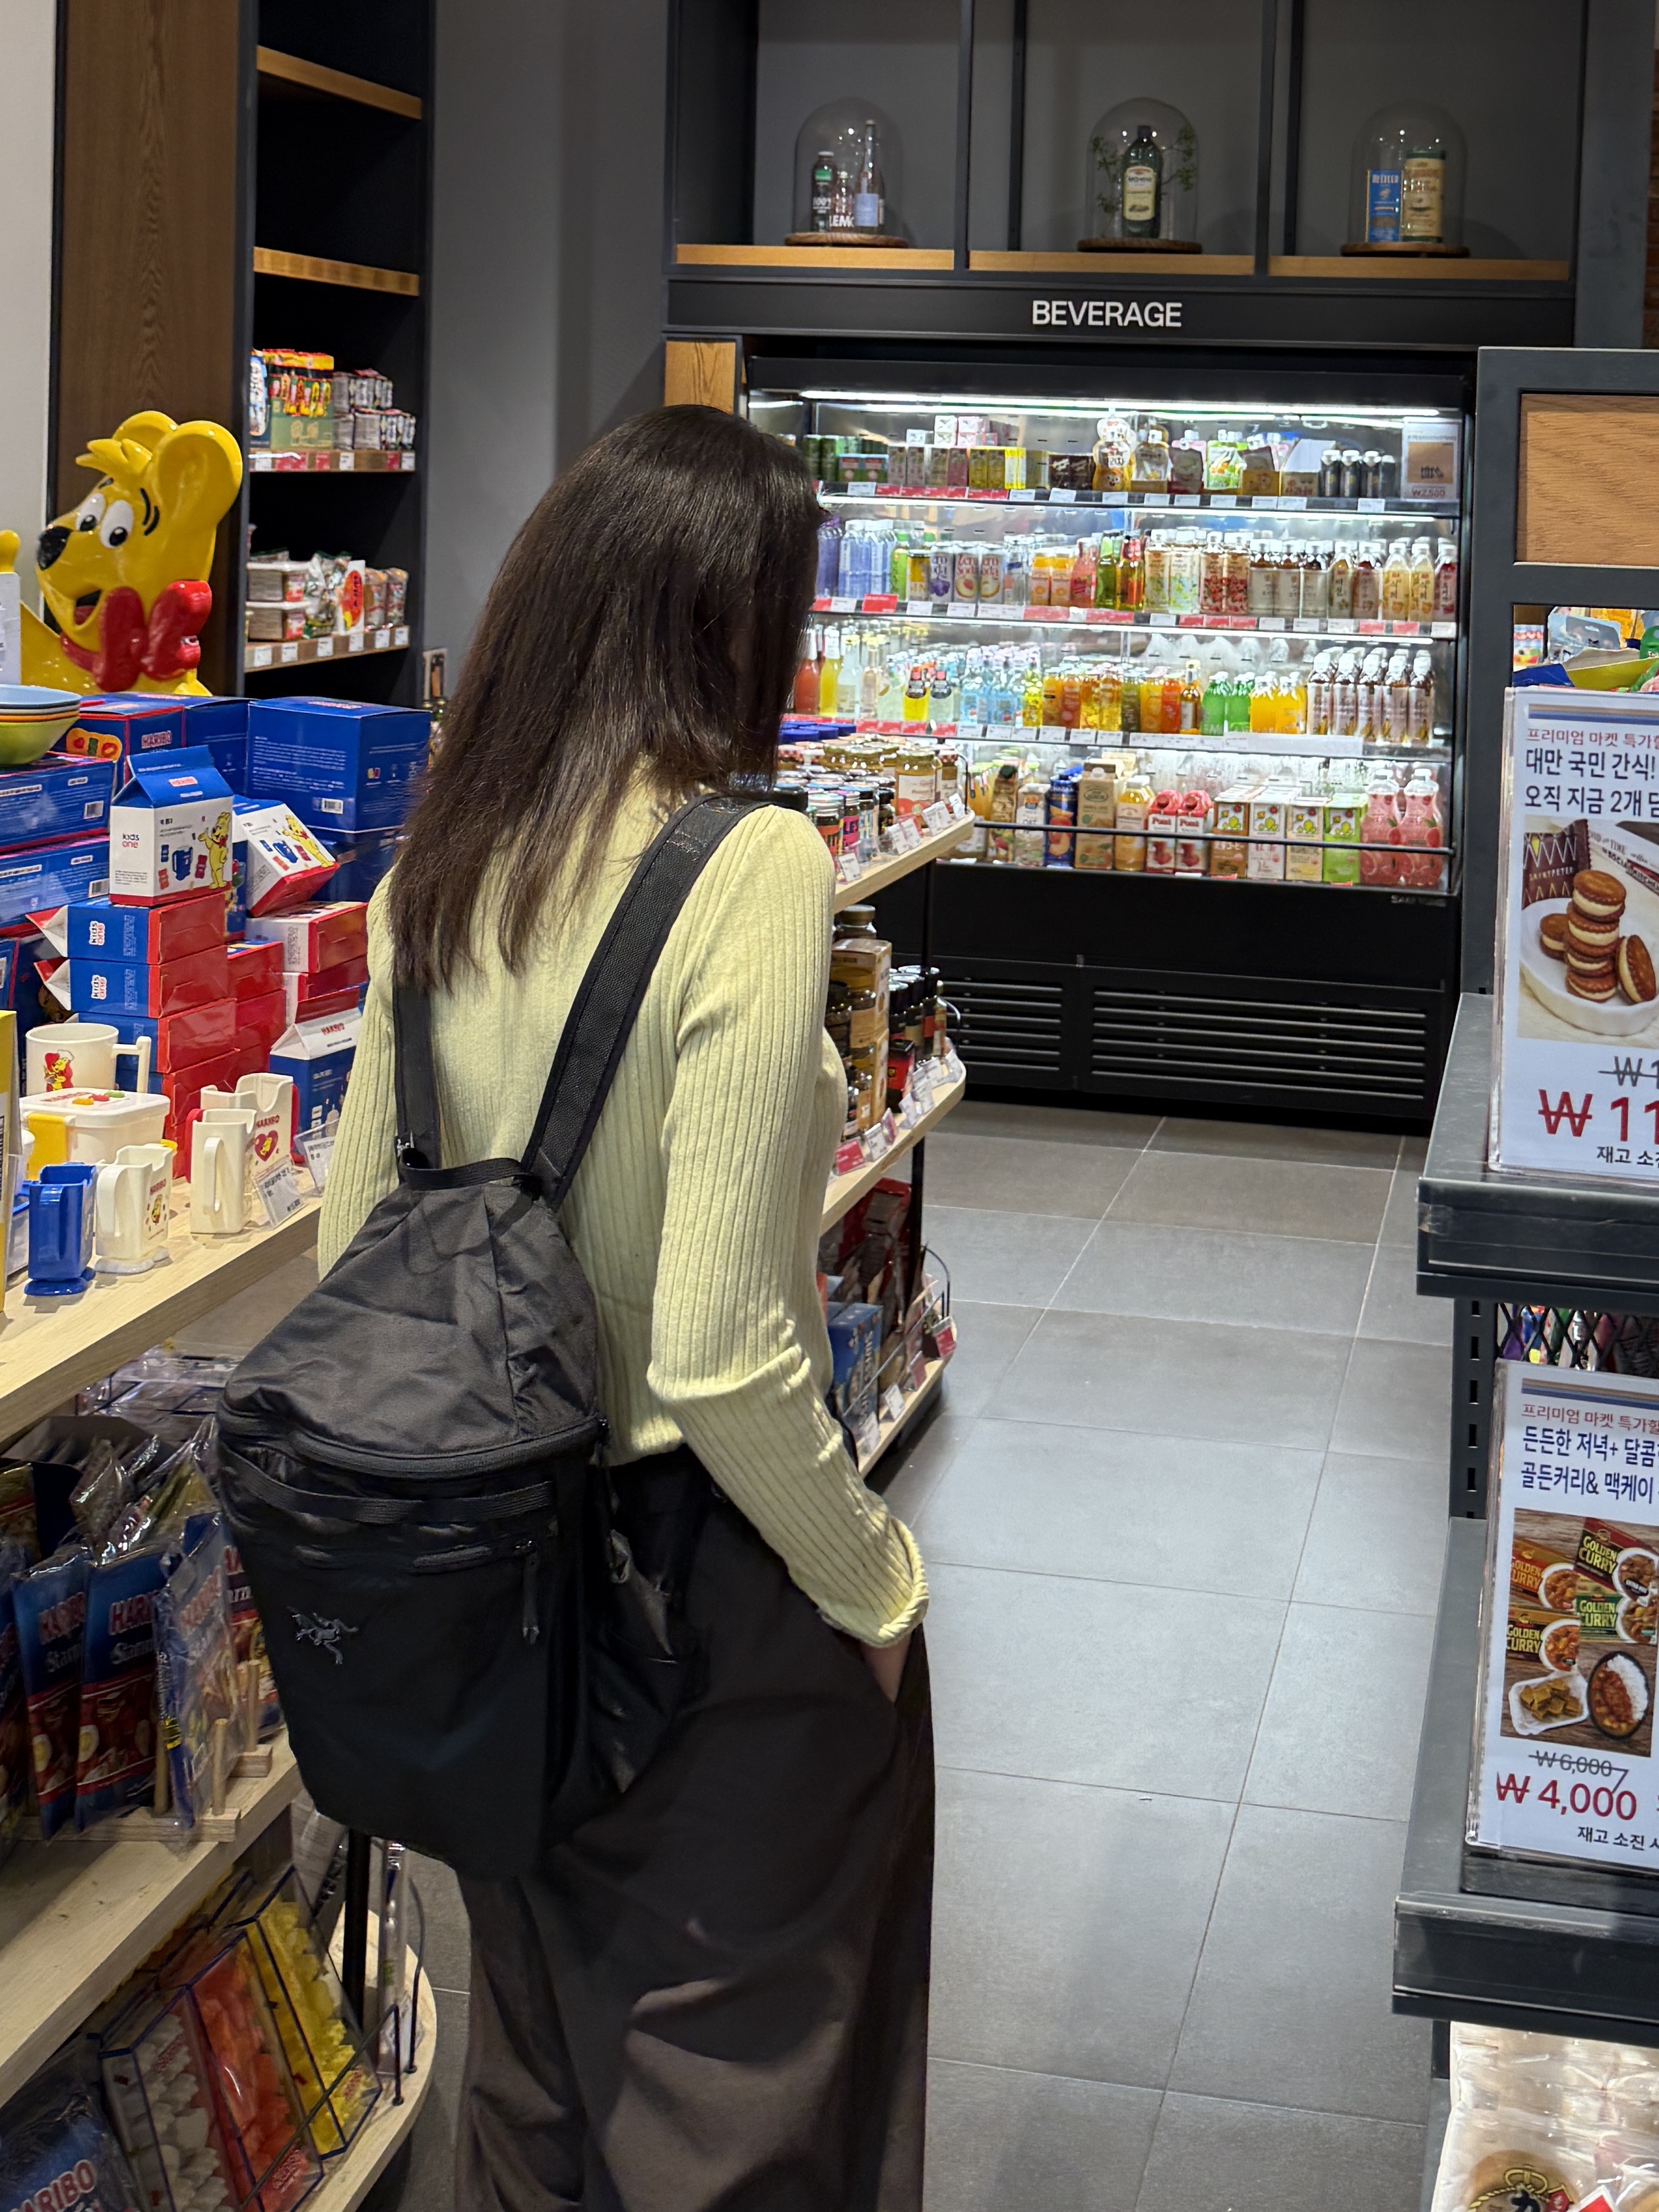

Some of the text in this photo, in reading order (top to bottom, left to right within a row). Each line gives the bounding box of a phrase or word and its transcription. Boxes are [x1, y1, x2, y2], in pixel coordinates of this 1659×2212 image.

[1032, 300, 1182, 327] BEVERAGE
[1526, 728, 1584, 745] 프리미엄
[1589, 731, 1617, 747] 마켓
[1526, 748, 1656, 781] 대만 국민 간식!
[1524, 785, 1561, 812] 오직
[1567, 786, 1604, 814] 지금
[1610, 789, 1642, 816] 2개
[1596, 1146, 1632, 1163] 재고
[1521, 1403, 1580, 1425] 프리미엄
[1584, 1411, 1613, 1429] 마켓
[1522, 1425, 1659, 1468] 든든한 저녁+ 달콤
[1520, 1461, 1654, 1504] 골든커리& 맥케이
[1579, 1547, 1617, 1574] CURRY
[1582, 1535, 1617, 1562] GOLDEN
[1511, 1568, 1542, 1588] URRY
[1579, 1600, 1615, 1614] GOLDEN
[1507, 1625, 1541, 1640] GOLDEN
[1495, 1771, 1637, 1821] ₩4,000
[1577, 1826, 1645, 1851] 재고 소진
